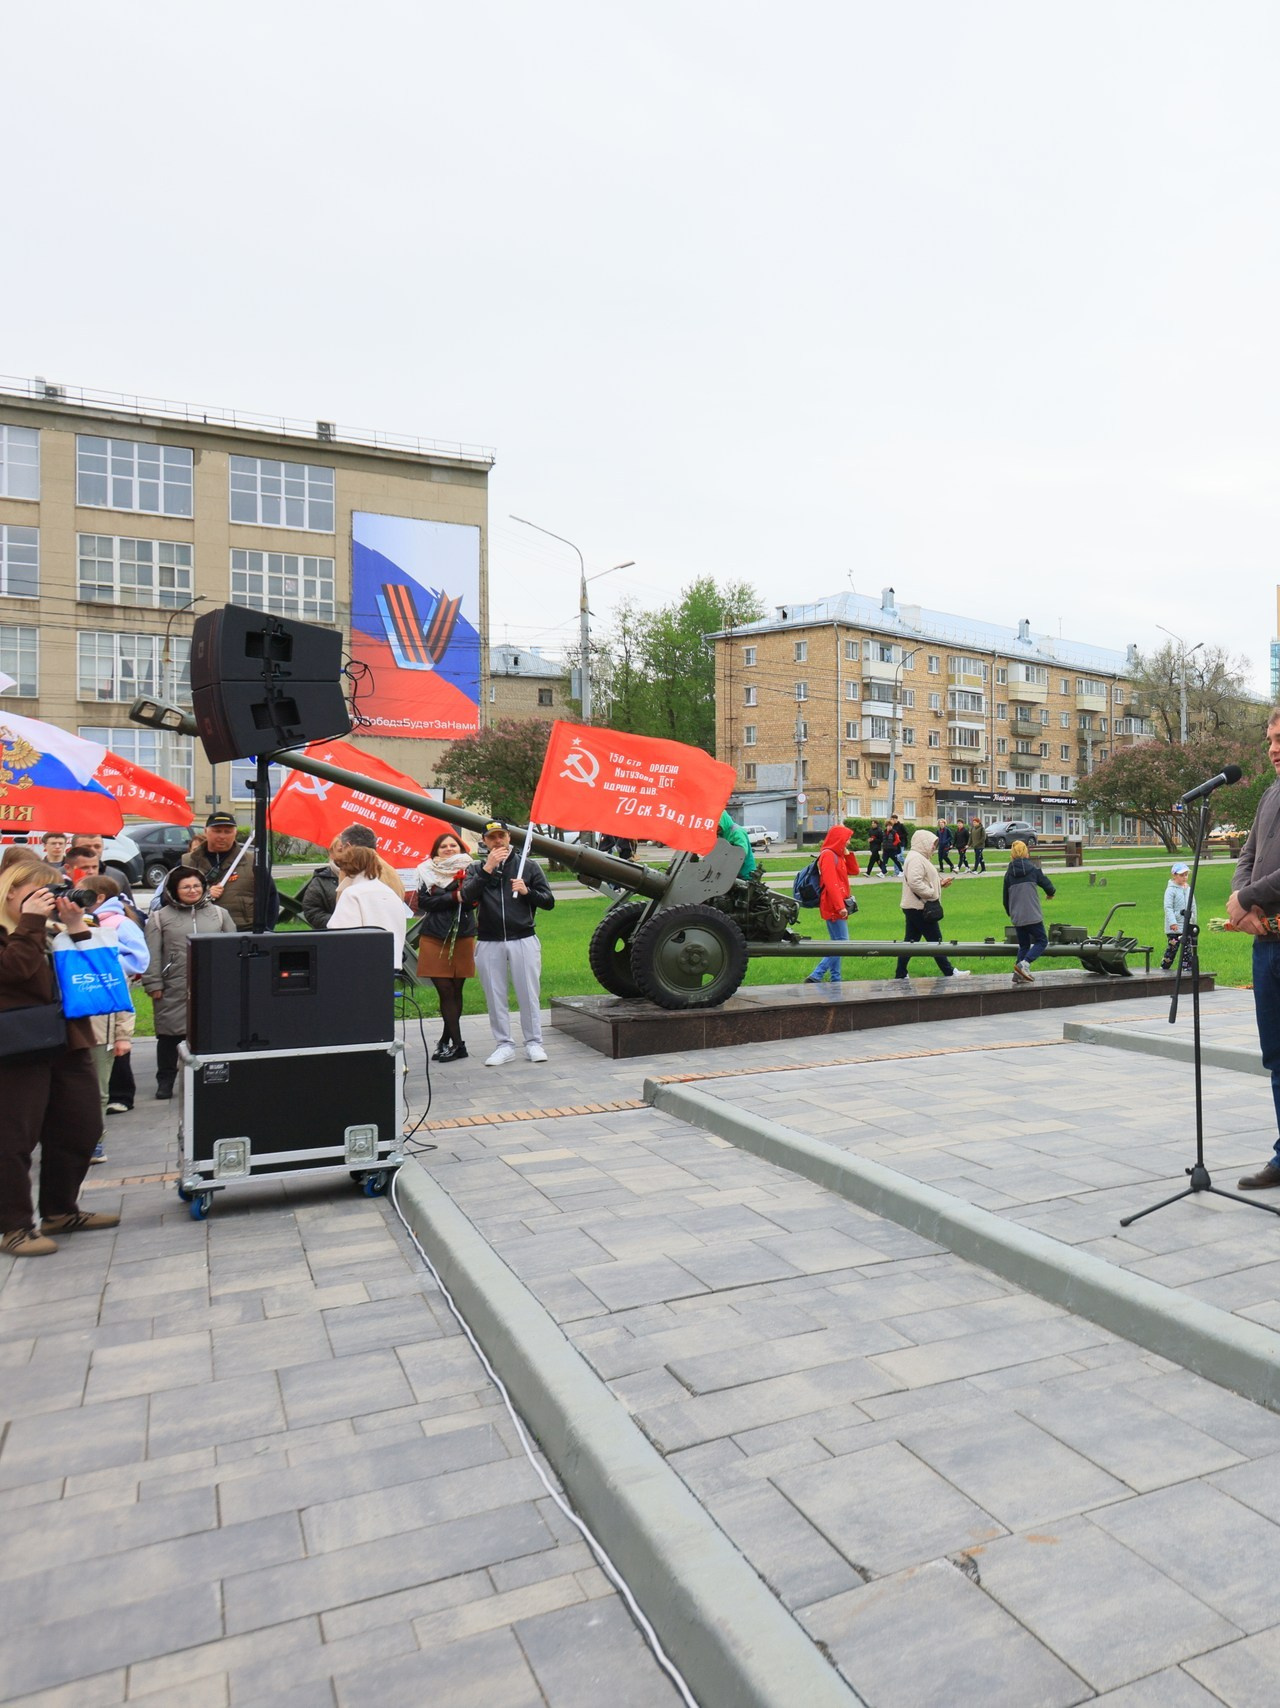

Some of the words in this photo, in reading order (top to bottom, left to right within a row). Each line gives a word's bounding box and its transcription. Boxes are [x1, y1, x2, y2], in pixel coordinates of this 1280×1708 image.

[610, 752, 625, 764] 150
[649, 763, 679, 775] ОРДЕНА
[615, 796, 638, 815] 79
[71, 973, 119, 984] ESTEL
